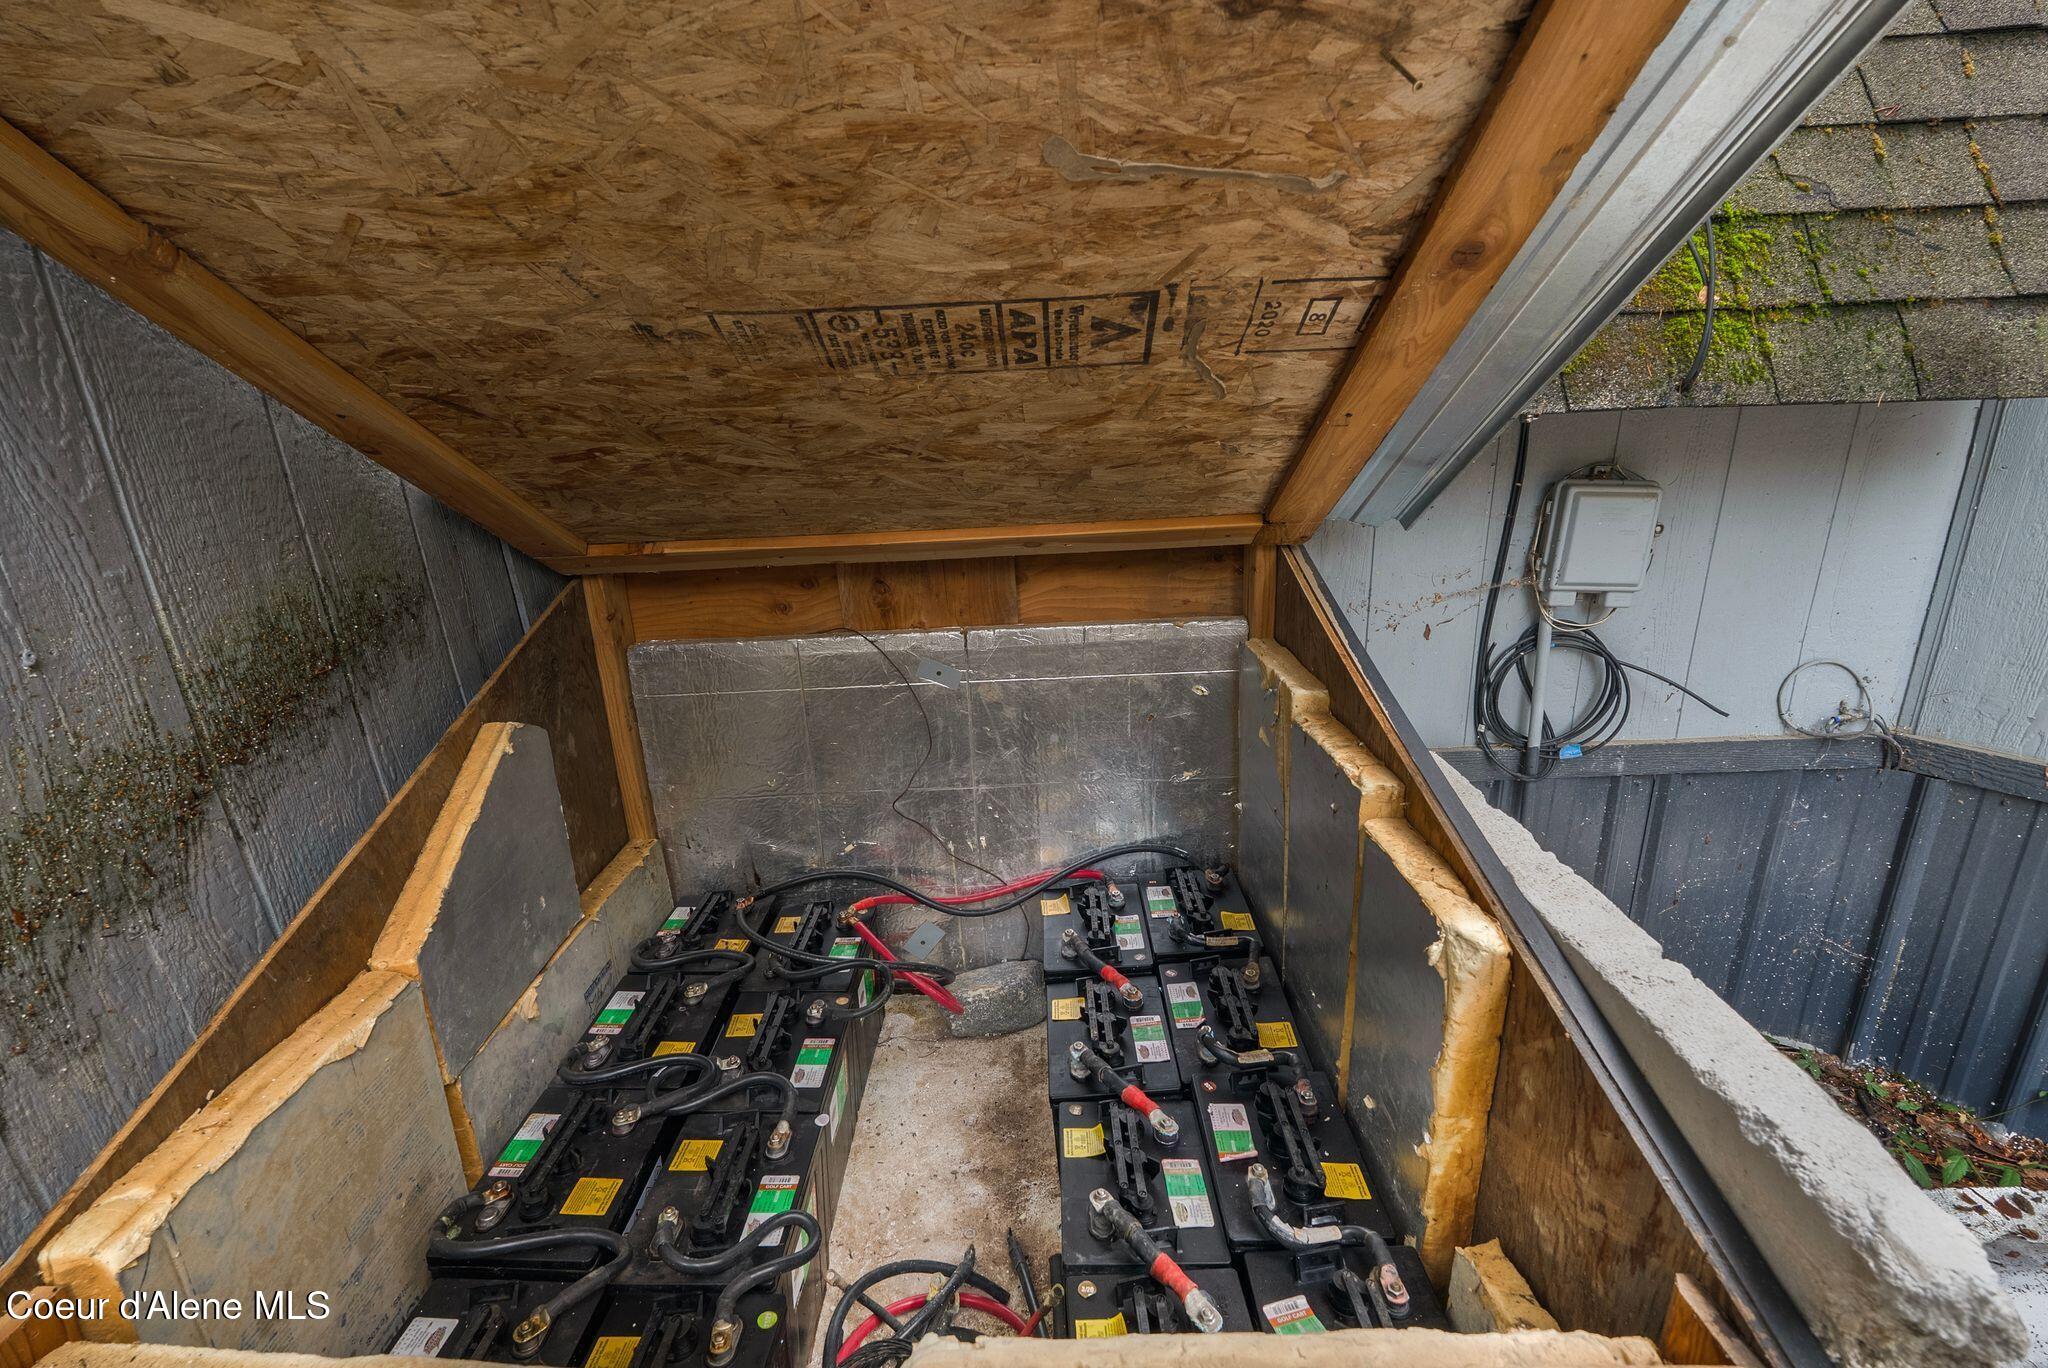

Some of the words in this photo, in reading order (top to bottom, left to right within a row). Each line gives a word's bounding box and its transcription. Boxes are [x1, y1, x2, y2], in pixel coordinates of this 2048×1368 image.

[1255, 301, 1281, 336] 2020
[1309, 313, 1327, 322] 8
[921, 318, 941, 359] EXPOSURE
[1009, 308, 1038, 364] APA
[1276, 1314, 1291, 1323] GOLF
[1292, 1310, 1307, 1319] CART
